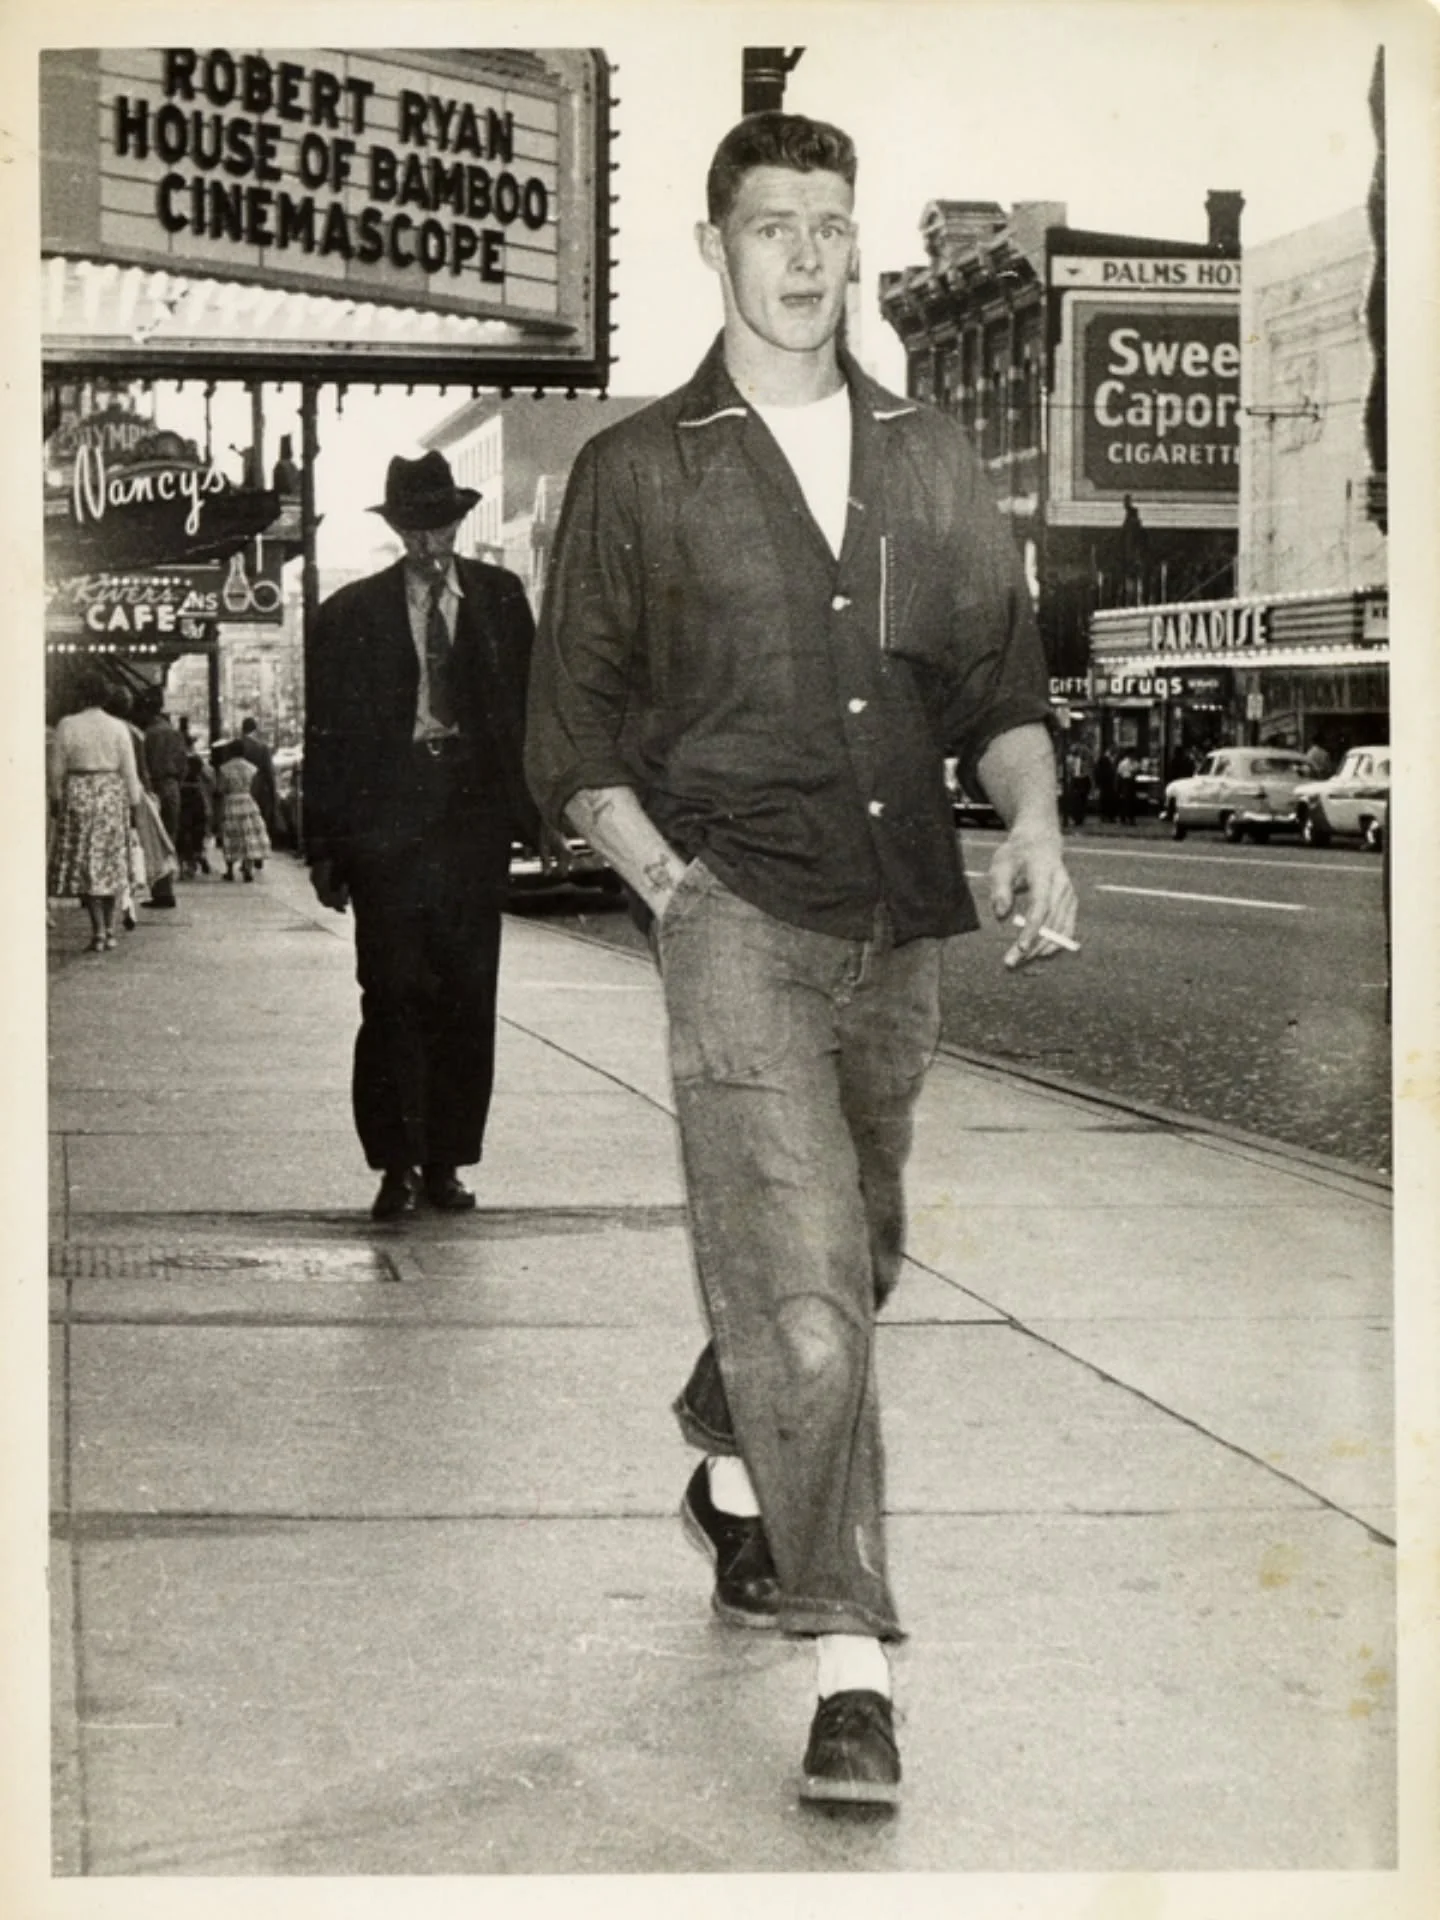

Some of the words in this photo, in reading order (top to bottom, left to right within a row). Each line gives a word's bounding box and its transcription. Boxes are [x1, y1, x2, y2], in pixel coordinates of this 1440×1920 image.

[163, 48, 374, 135] ROBERT
[399, 89, 514, 163] RYAN
[114, 95, 282, 182] HOUSE
[299, 131, 355, 192] OF
[367, 143, 549, 230] BAMBOO
[156, 172, 506, 284] CINEMASCOPE
[1102, 261, 1187, 284] PALMS
[1107, 327, 1241, 378] Swee
[86, 603, 176, 633] CAFE
[1151, 603, 1267, 651] PARADISE
[1110, 675, 1183, 699] drugs
